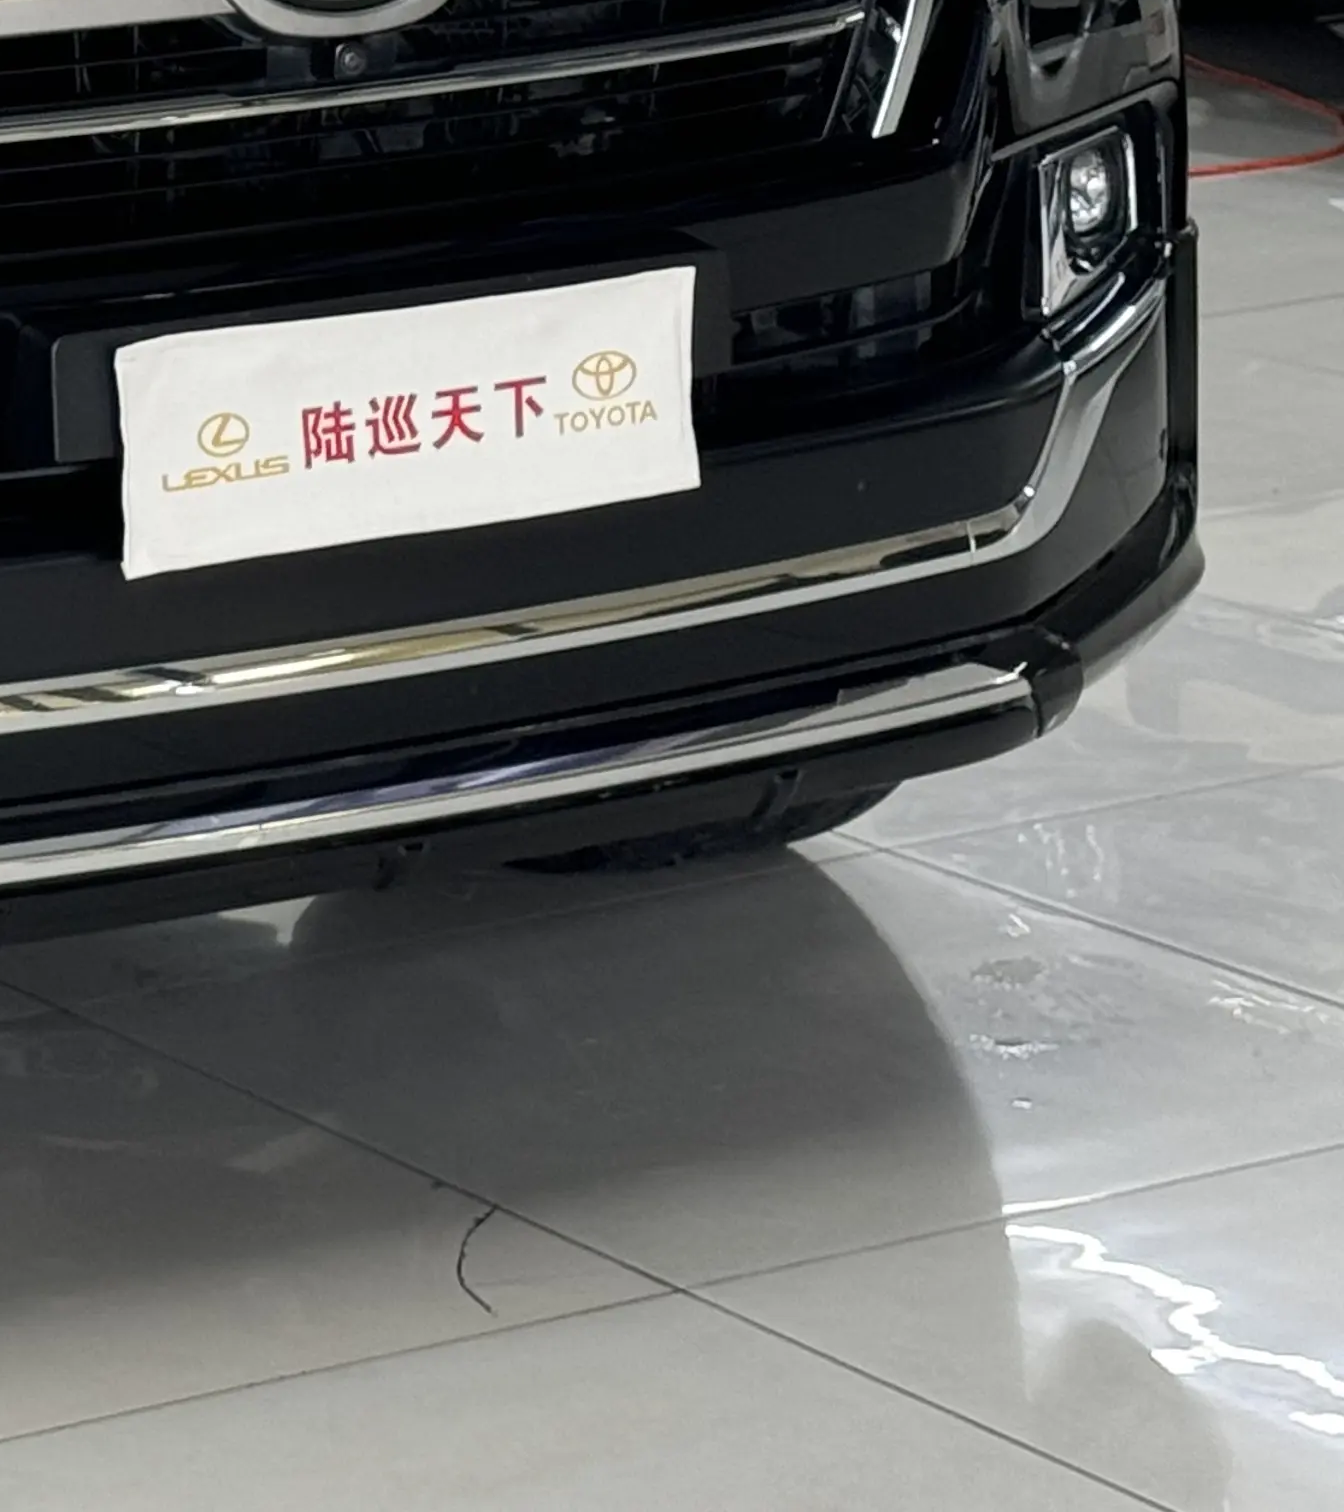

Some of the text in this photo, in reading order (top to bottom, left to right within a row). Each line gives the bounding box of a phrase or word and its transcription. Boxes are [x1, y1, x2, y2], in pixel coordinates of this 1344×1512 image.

[301, 375, 548, 470] 陆巡天下
[553, 399, 658, 436] TOYOTA
[161, 454, 291, 492] LEXUS
